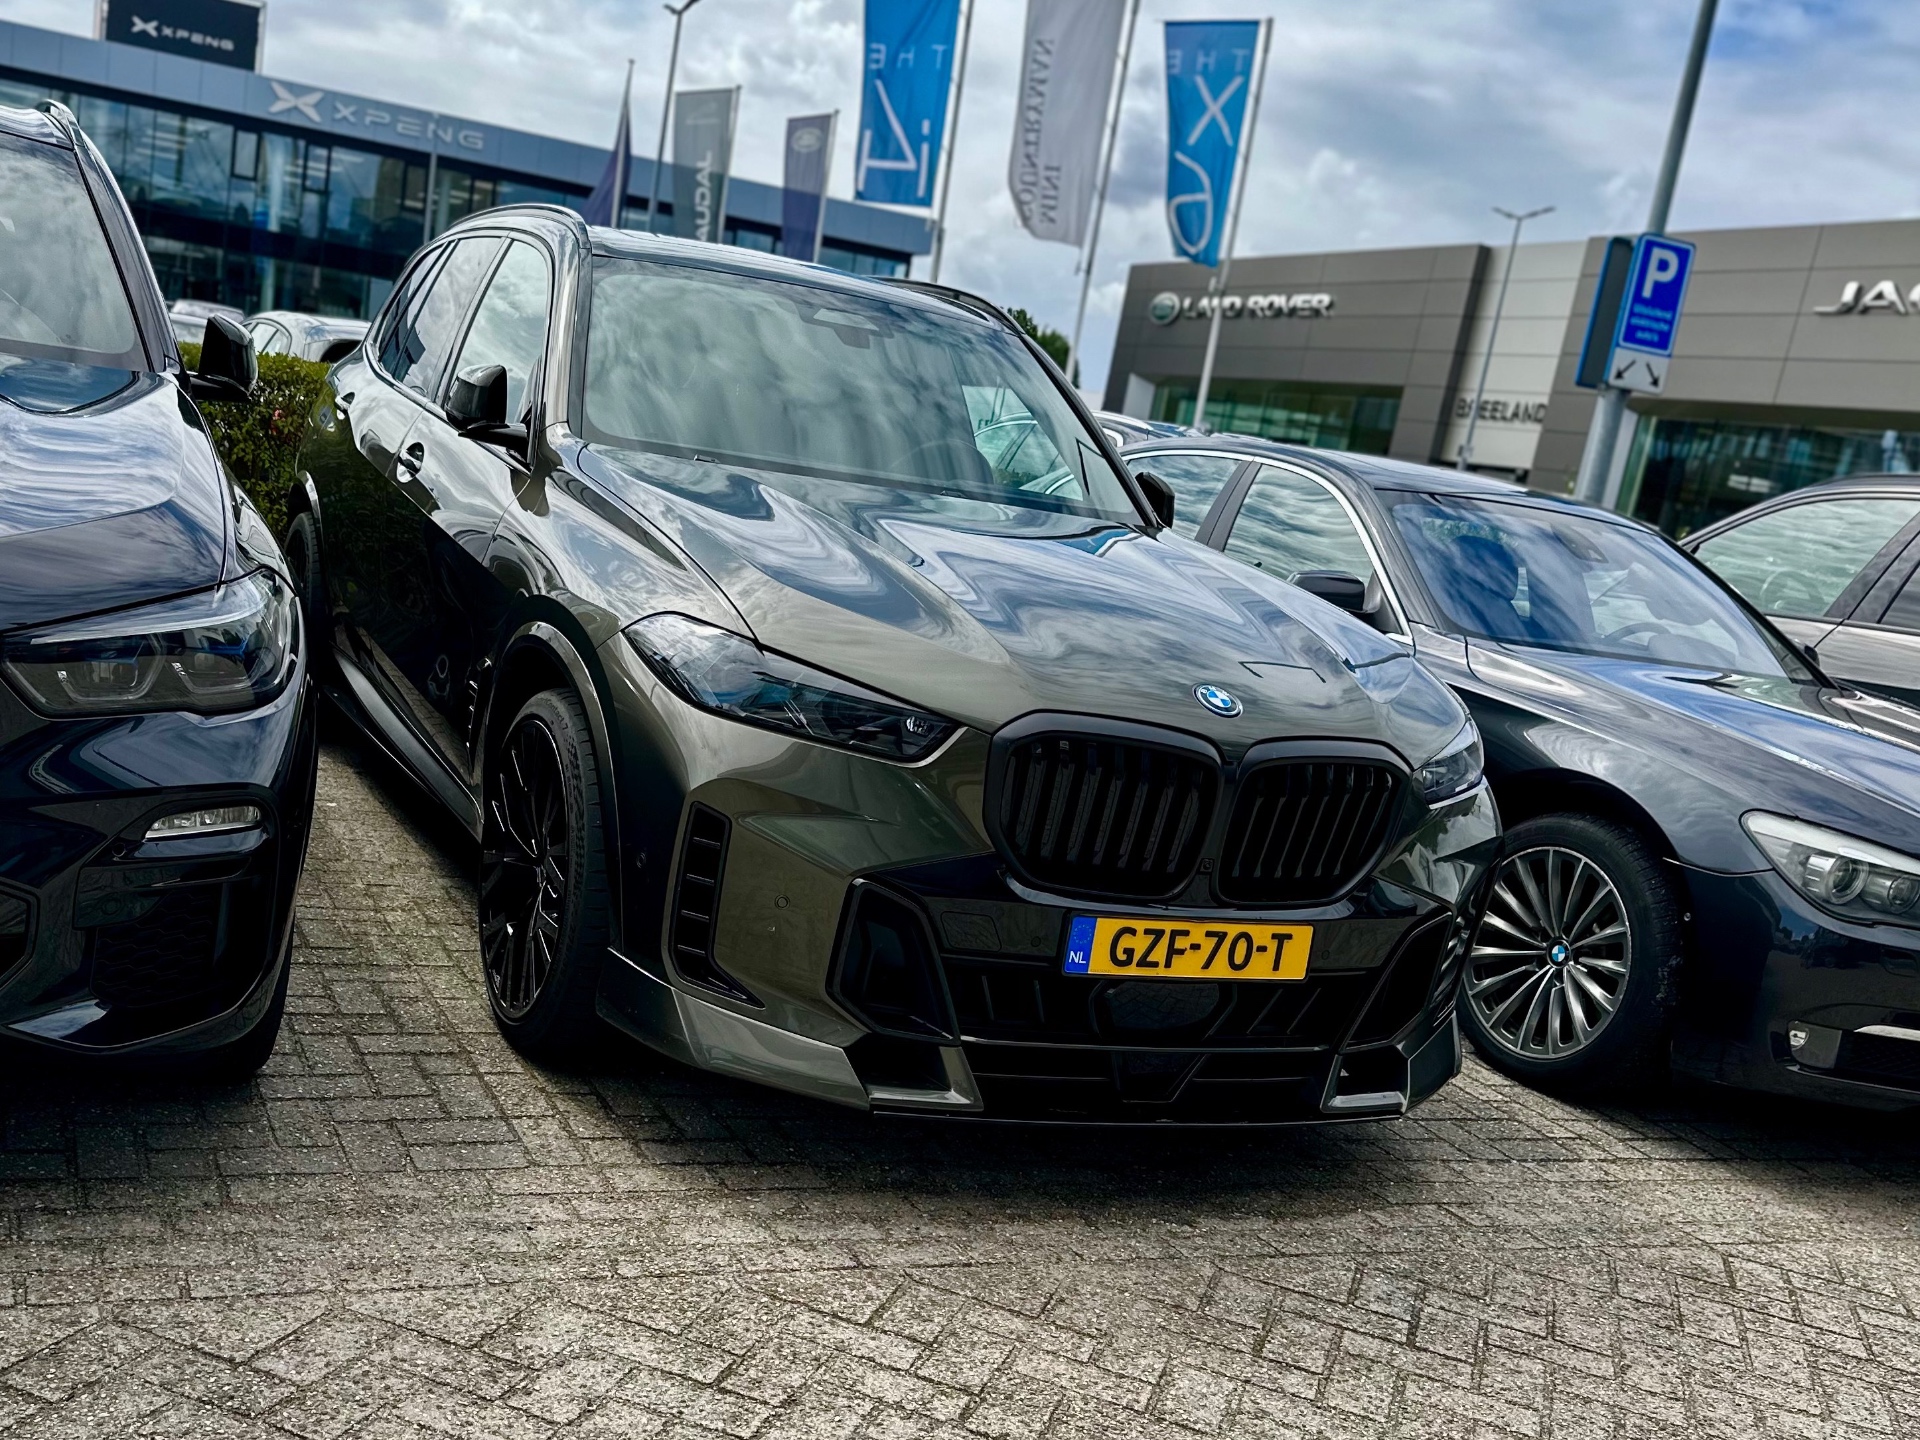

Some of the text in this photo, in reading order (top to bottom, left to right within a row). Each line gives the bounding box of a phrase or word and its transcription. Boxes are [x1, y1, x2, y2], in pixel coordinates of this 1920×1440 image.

[161, 25, 235, 51] XPENG
[333, 101, 484, 149] XPENG
[1642, 246, 1679, 299] P
[1247, 293, 1334, 319] ROVER
[1813, 280, 1920, 314] JA
[1068, 950, 1087, 964] NL
[1109, 926, 1294, 972] GZF-70-T
